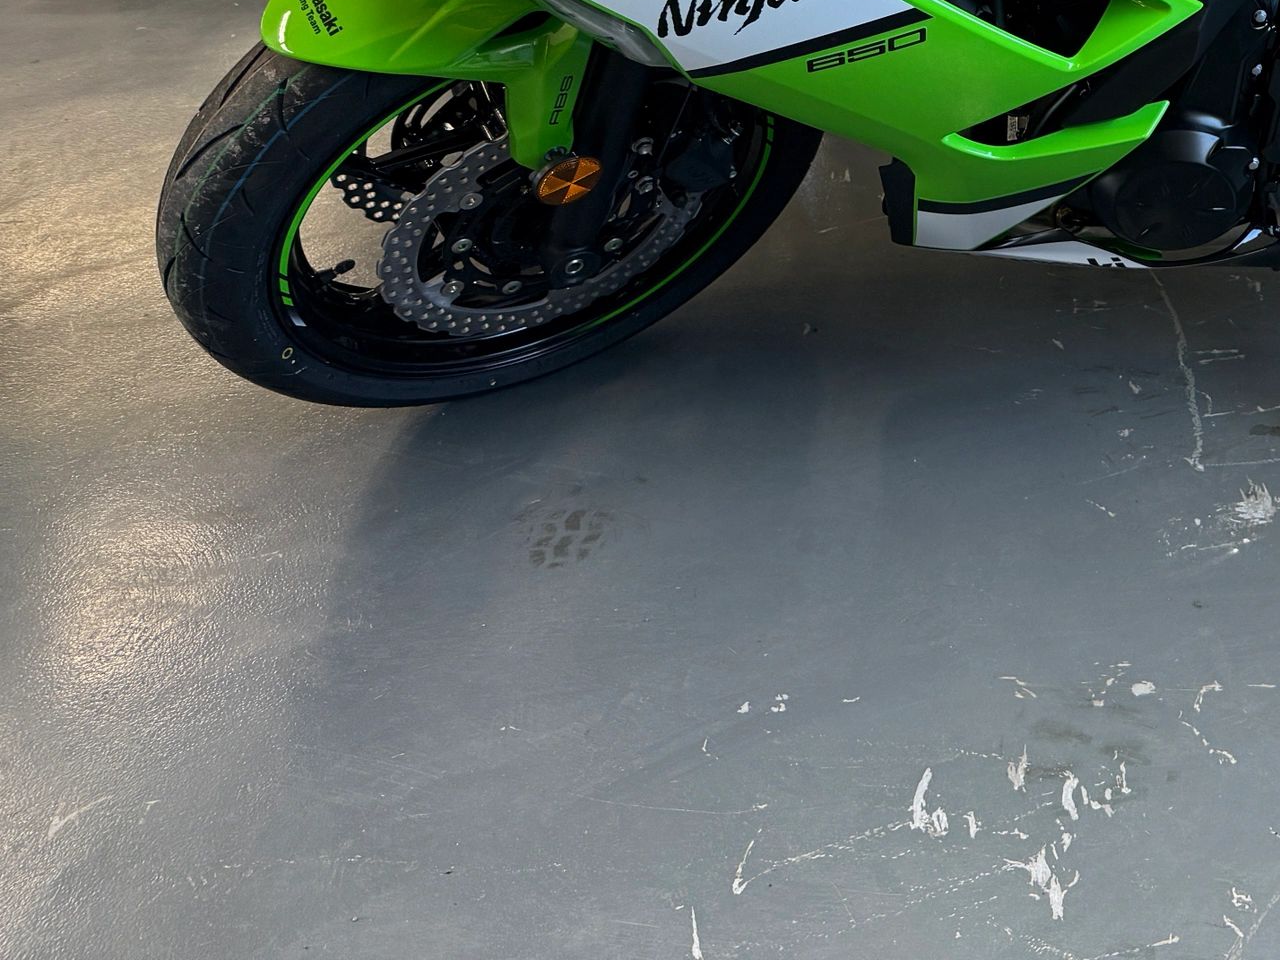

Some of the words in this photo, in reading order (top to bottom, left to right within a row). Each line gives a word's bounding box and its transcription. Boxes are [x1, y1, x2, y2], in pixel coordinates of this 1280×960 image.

[306, 9, 322, 35] Team
[806, 26, 928, 73] 650
[549, 75, 574, 126] ABS
